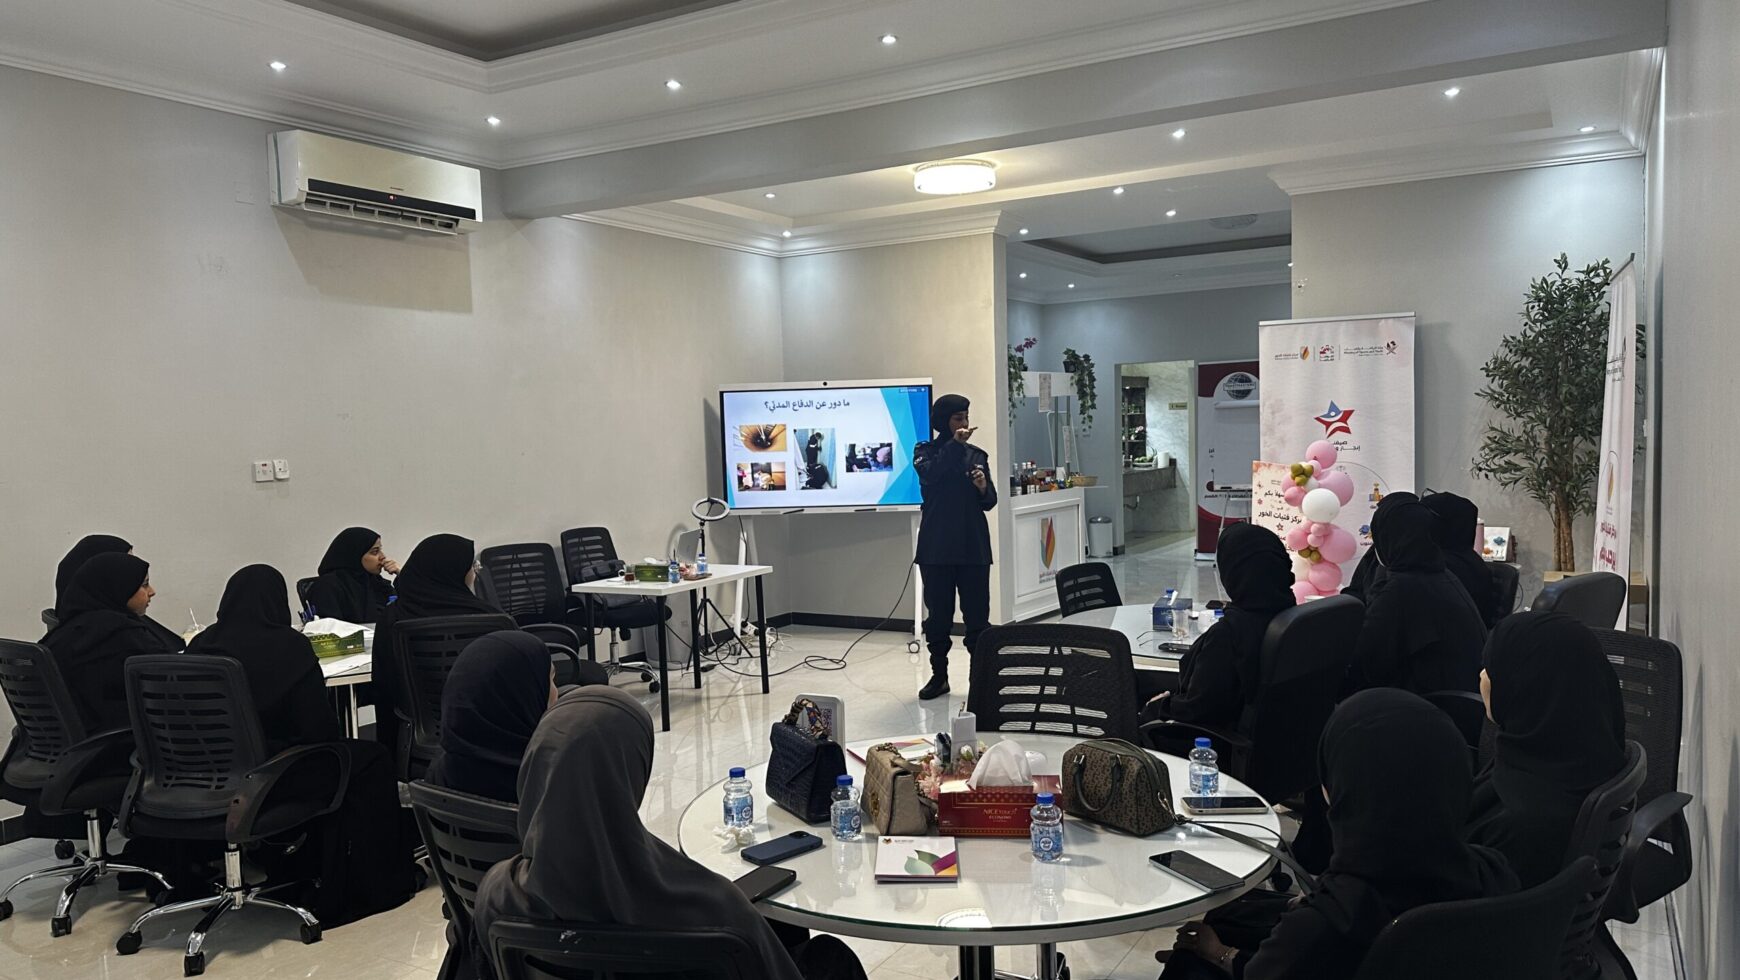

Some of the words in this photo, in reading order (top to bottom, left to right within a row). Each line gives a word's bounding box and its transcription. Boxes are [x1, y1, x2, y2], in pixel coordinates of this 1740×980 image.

[792, 399, 813, 412] الدفاع
[815, 401, 827, 410] عن
[828, 401, 843, 410] دور
